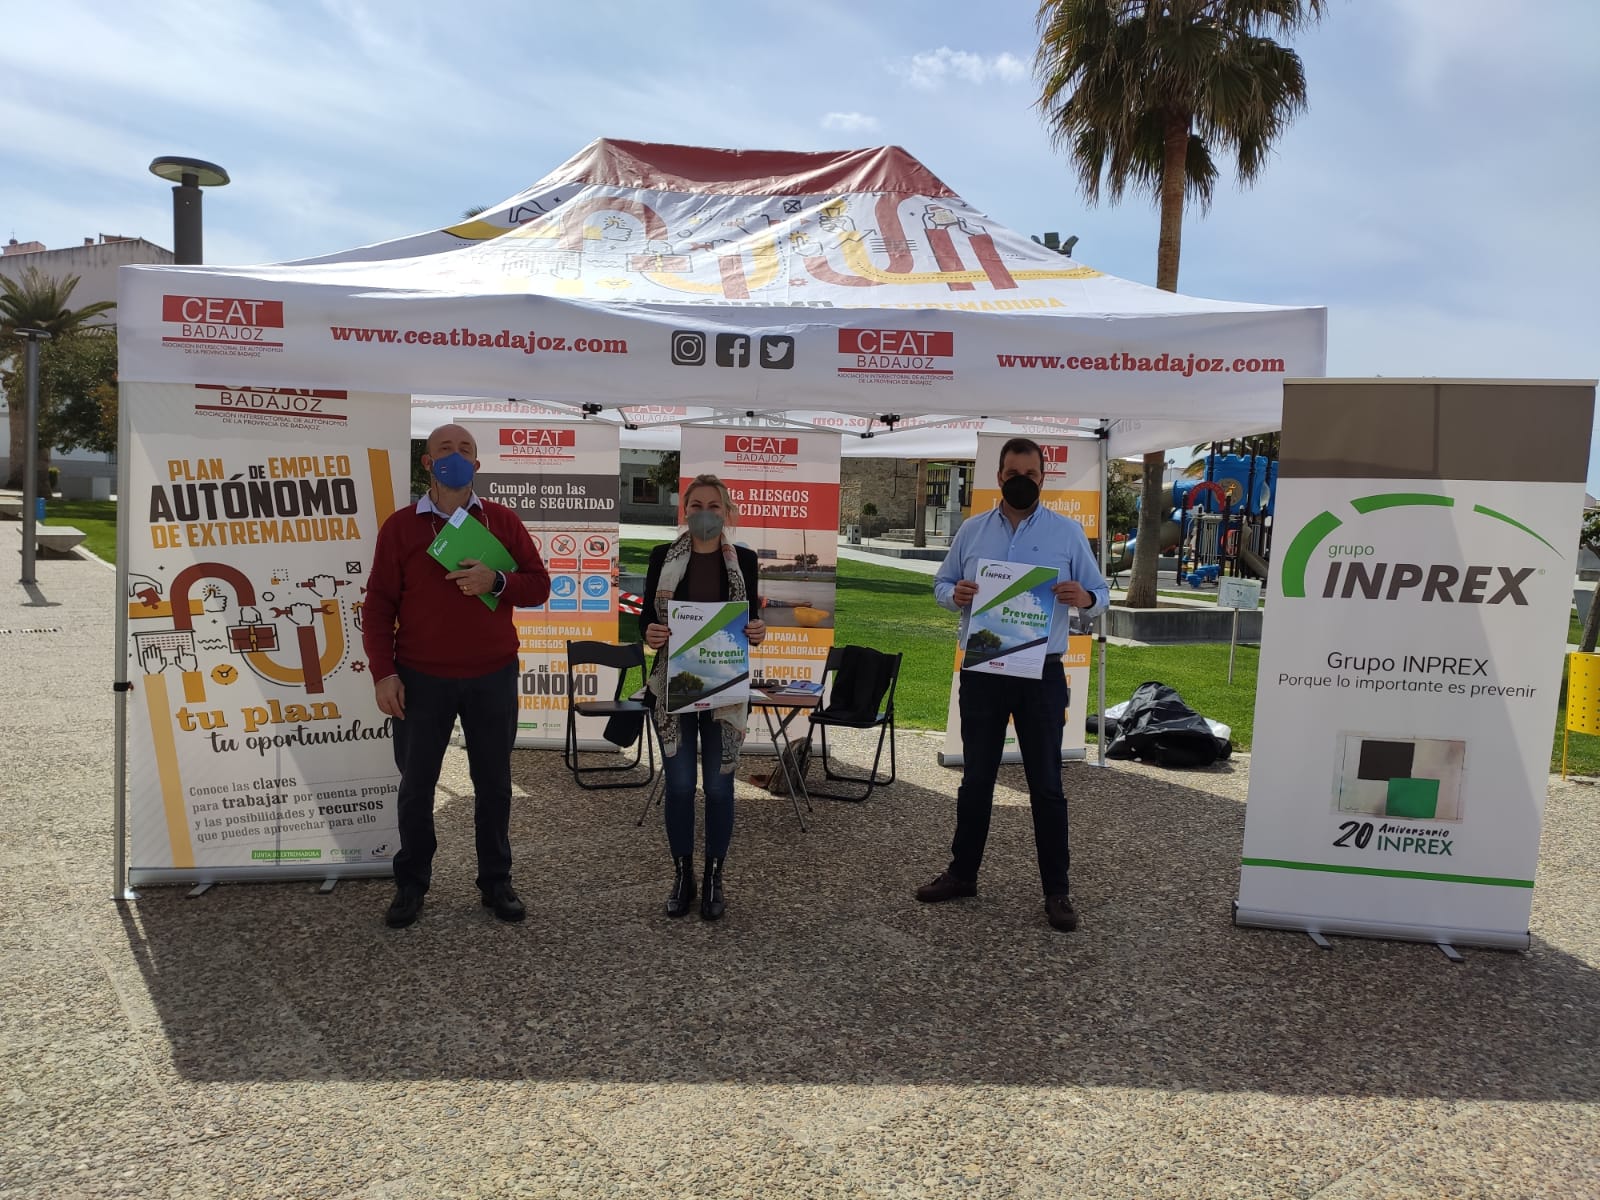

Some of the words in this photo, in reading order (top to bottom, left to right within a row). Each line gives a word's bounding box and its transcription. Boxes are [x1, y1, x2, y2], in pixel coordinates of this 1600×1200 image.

[182, 297, 264, 325] CEAT
[182, 324, 264, 341] BADAJOZ
[330, 326, 628, 354] www.ceatbadajoz.com
[857, 331, 935, 355] CEAT
[857, 355, 934, 369] BADAJOZ
[997, 353, 1285, 377] www.ceatbadajoz.com
[221, 392, 322, 412] BADAJOZ
[243, 419, 279, 427] PROVINCIA
[290, 422, 320, 430] BADAJOZ
[511, 430, 563, 445] CEAT
[736, 437, 787, 454] CEAT
[512, 446, 563, 455] BADAJOZ
[736, 453, 786, 462] BADAJOZ
[1042, 446, 1059, 462] AT
[168, 458, 225, 481] PLAN
[248, 465, 266, 479] DE
[268, 455, 351, 479] EMPLEO
[489, 482, 537, 496] Cumple
[541, 485, 562, 495] con
[566, 483, 586, 495] las
[727, 487, 744, 500] ita
[749, 488, 809, 503] RIESGOS
[149, 473, 358, 523] AUTÓNOMO
[521, 497, 536, 509] de
[540, 497, 615, 510] SEGURIDAD
[737, 503, 808, 518] CIDENTES
[151, 524, 182, 549] DE
[186, 517, 360, 548] EXTREMADURA
[1328, 542, 1375, 558] grupo
[985, 571, 1013, 581] INPREX
[1322, 561, 1537, 606] INPREX
[677, 613, 704, 621] INPREX
[1002, 606, 1048, 621] Prevenir
[559, 626, 581, 636] PARA
[582, 627, 592, 636] LA
[775, 632, 797, 642] PARA
[798, 632, 808, 642] LA
[529, 640, 564, 648] RIESGOS
[699, 647, 745, 657] Prevenir
[750, 645, 779, 655] ESGOS
[781, 645, 828, 656] LABORALES
[538, 664, 549, 672] DE
[550, 660, 597, 673] EMLEO
[1327, 651, 1395, 675] Grupo
[1403, 655, 1489, 676] INPREX
[754, 669, 764, 678] DE
[765, 666, 812, 679] EMPLEO
[521, 669, 598, 695] ÓNOMO
[1278, 673, 1332, 688] Porque
[1336, 674, 1350, 688] lo
[1355, 675, 1443, 692] importante
[1448, 683, 1466, 694] es
[1470, 684, 1536, 698] prevenir
[176, 706, 228, 732] tu
[241, 699, 342, 732] plan
[204, 731, 239, 753] tu
[246, 717, 393, 757] oportunidad
[189, 784, 229, 796] Conoce
[232, 782, 250, 792] las
[253, 777, 297, 790] claves
[192, 802, 219, 814] para
[221, 793, 289, 809] trabajar
[293, 793, 313, 804] por
[316, 789, 358, 800] cuenta
[360, 783, 398, 797] propia
[195, 820, 201, 830] y
[204, 818, 222, 827] las
[225, 809, 305, 827] posibilidades
[308, 808, 315, 818] y
[318, 800, 384, 815] recursos
[197, 832, 218, 843] que
[221, 826, 260, 840] puedes
[263, 820, 325, 836] aprovechar
[328, 818, 354, 829] para
[357, 814, 376, 824] ello
[1333, 821, 1374, 849] 20
[1378, 823, 1450, 838] Aniversario
[1377, 835, 1453, 856] INPREX
